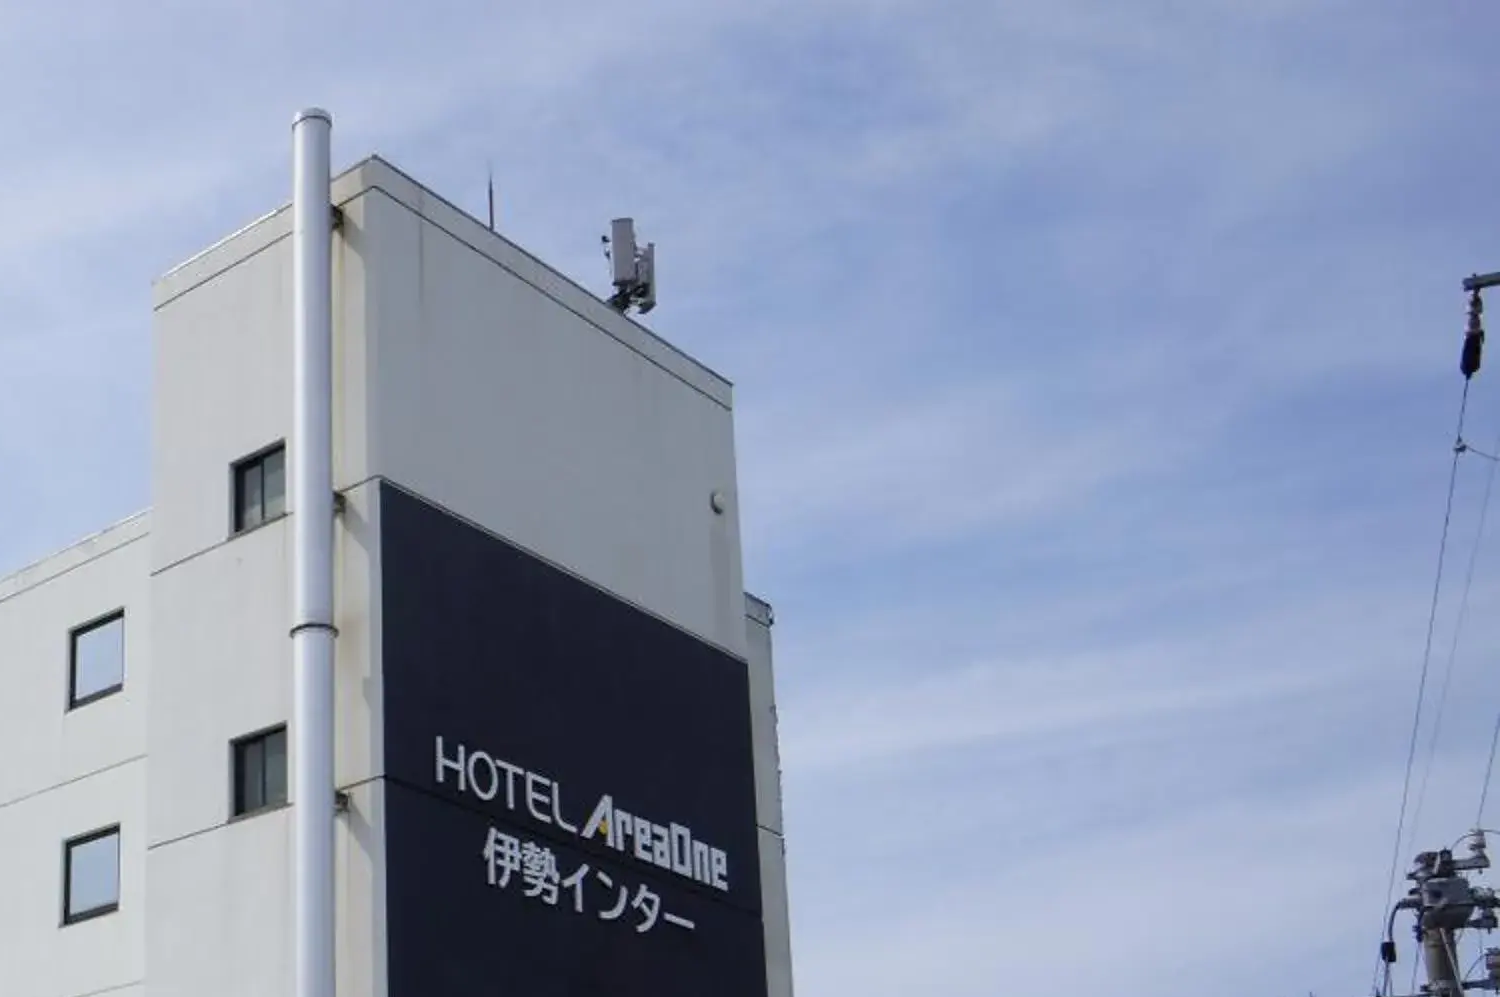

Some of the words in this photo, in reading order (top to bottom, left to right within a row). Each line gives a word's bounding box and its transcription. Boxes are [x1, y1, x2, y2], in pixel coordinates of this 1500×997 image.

[435, 735, 578, 833] HOTEL
[580, 793, 729, 892] AreaOne
[483, 826, 695, 933] 伊勢インター
